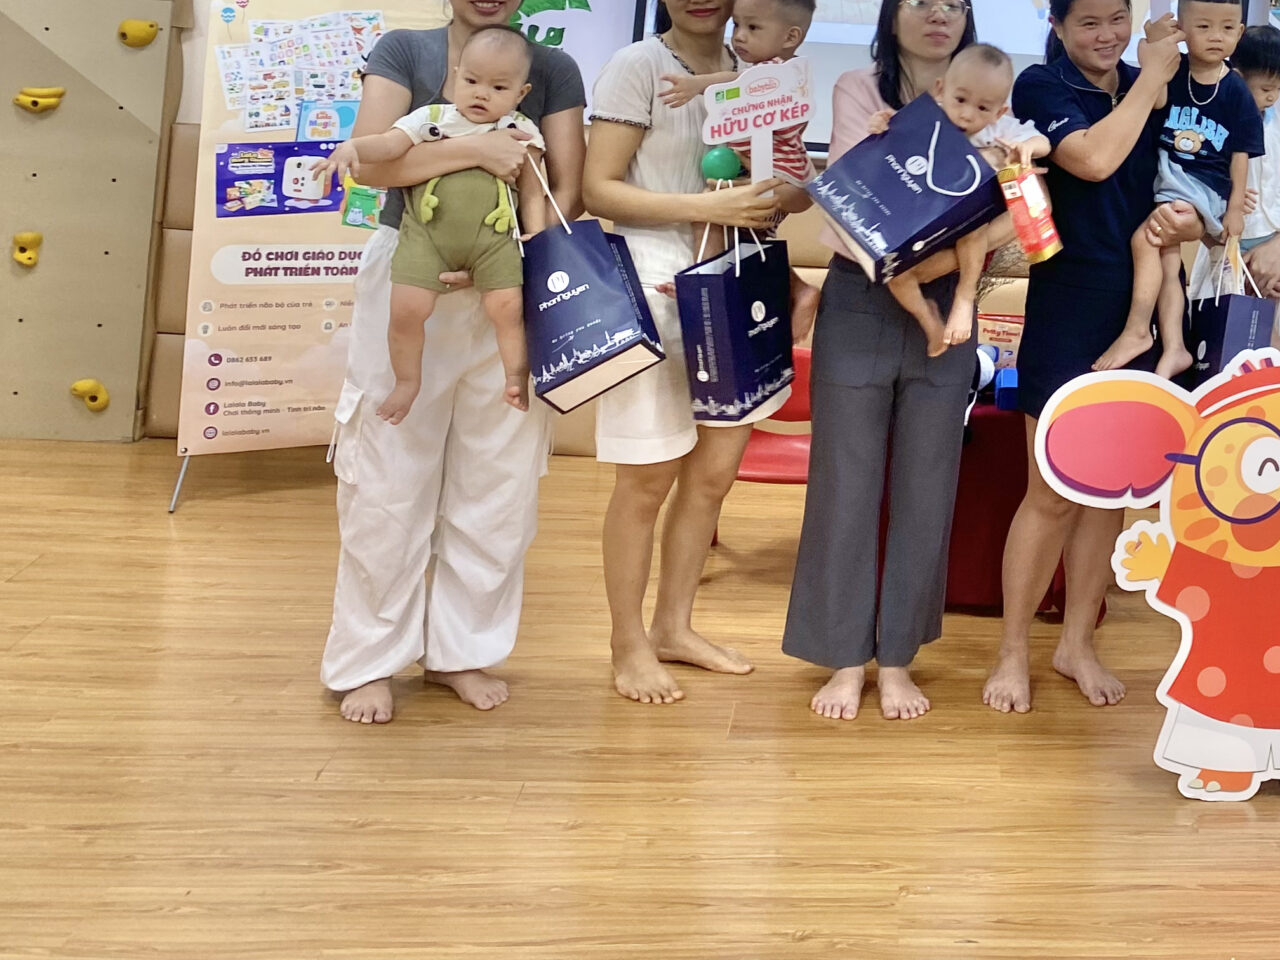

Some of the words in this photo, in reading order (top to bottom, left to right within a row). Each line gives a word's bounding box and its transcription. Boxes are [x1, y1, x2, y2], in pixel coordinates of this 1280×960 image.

[732, 100, 765, 116] CHỨNG
[767, 94, 792, 108] NHẬN
[710, 117, 748, 139] HỮU
[752, 110, 776, 128] CƠ
[780, 102, 810, 122] KÉP
[302, 249, 335, 261] GIÁO
